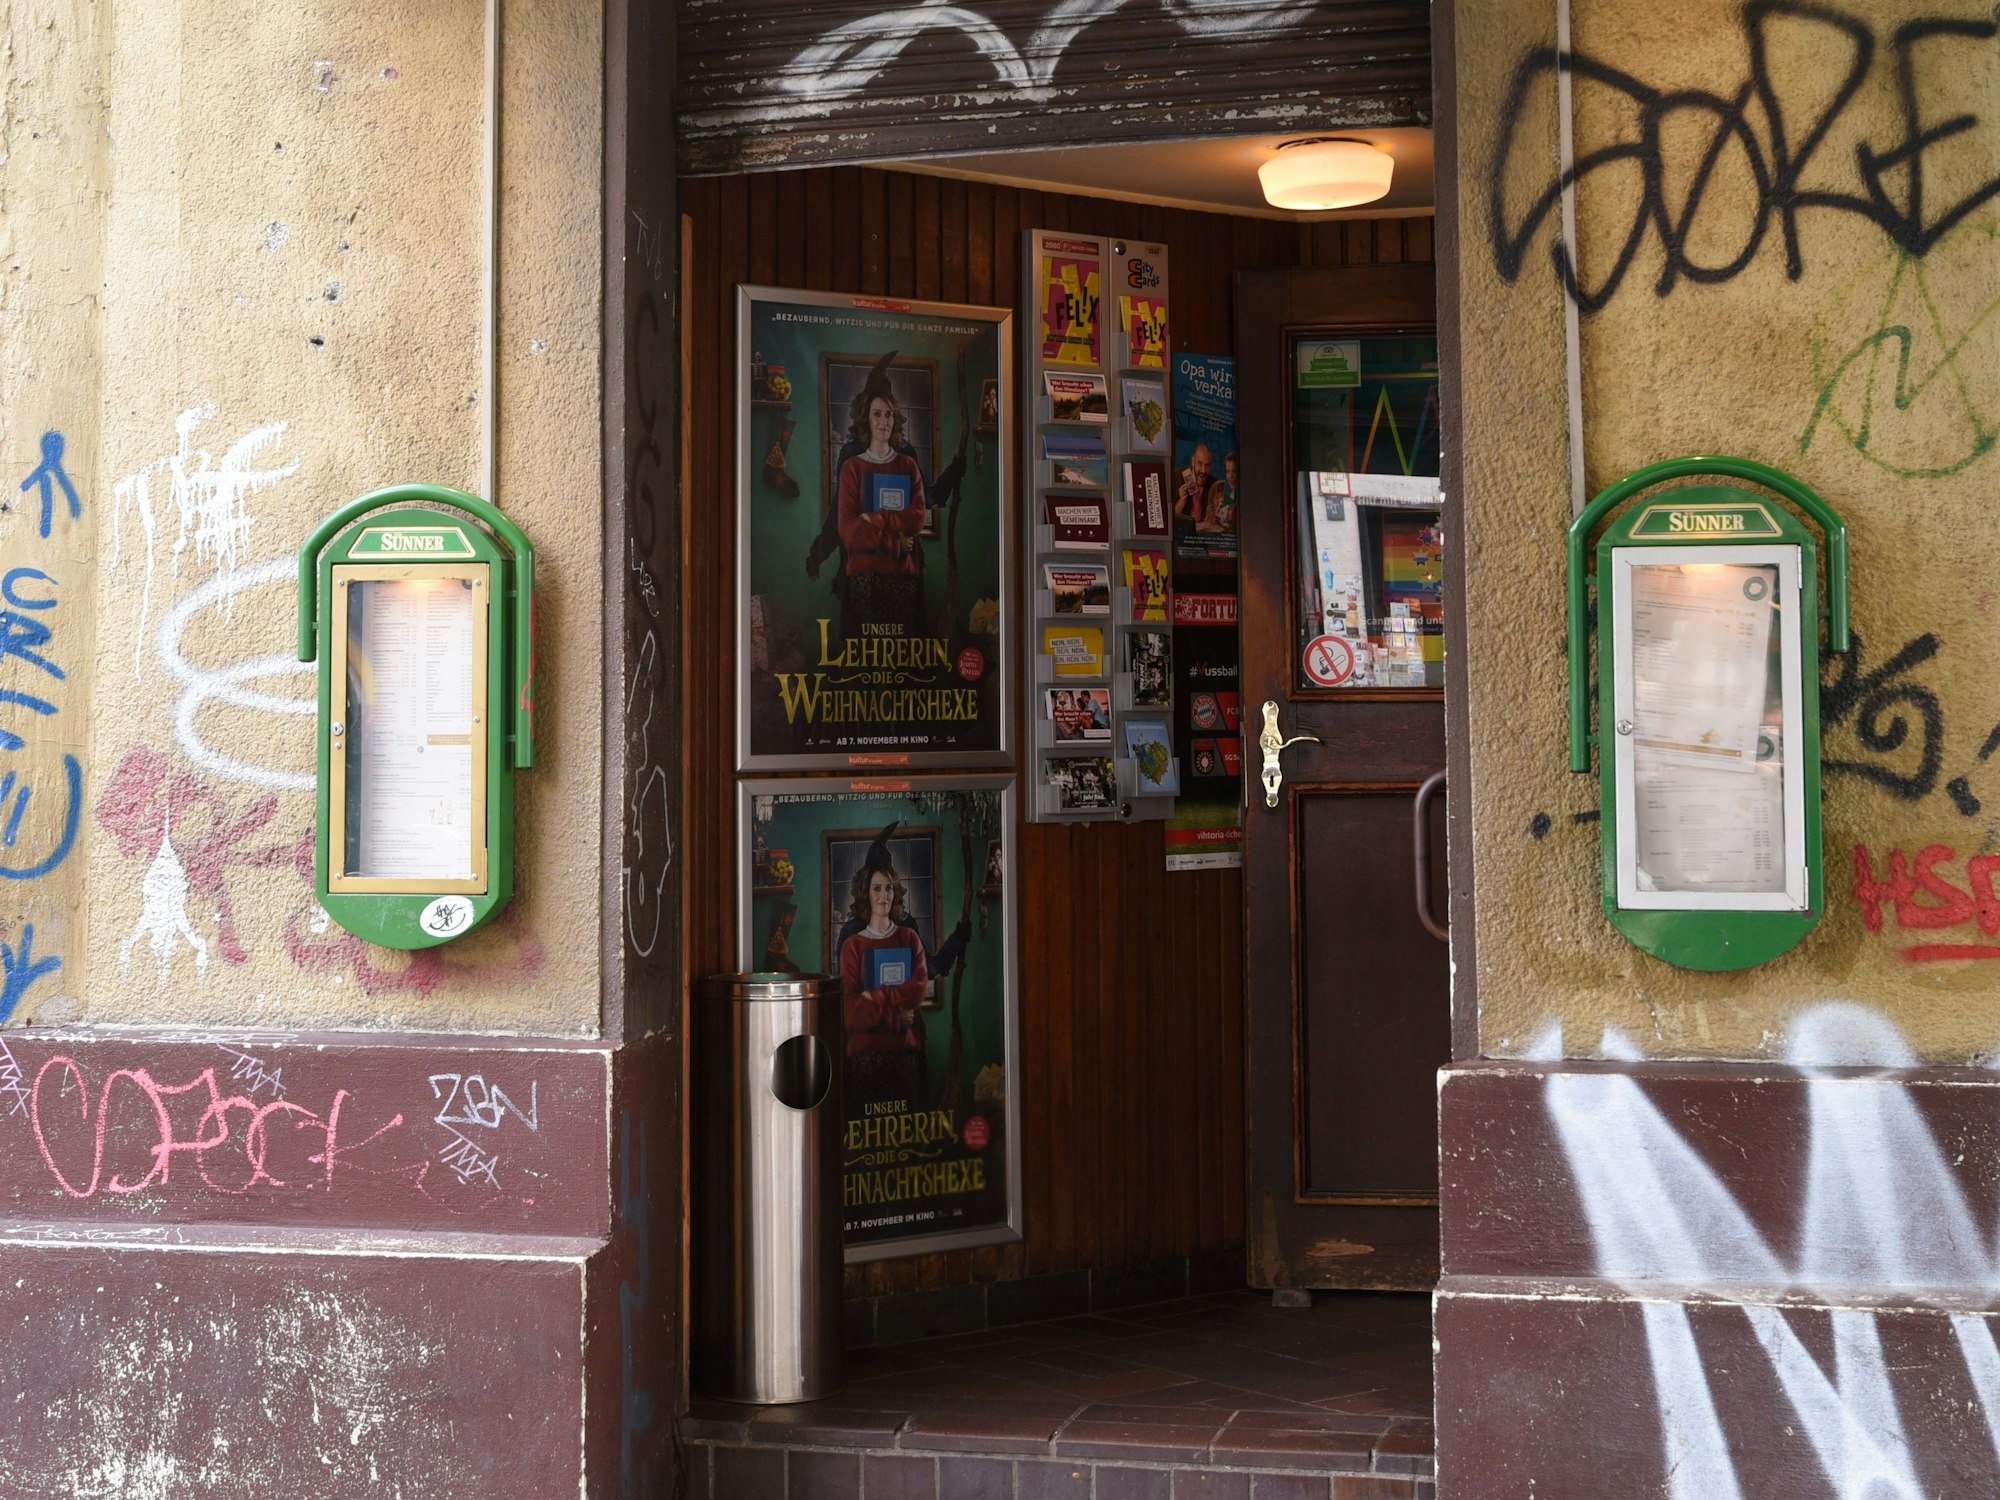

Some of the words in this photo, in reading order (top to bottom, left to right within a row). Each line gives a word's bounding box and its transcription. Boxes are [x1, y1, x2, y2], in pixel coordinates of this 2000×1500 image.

[1181, 359, 1205, 381] Opa
[1210, 368, 1236, 385] wir
[1194, 380, 1235, 400] verka
[1669, 511, 1745, 532] SÜNNER
[381, 532, 444, 551] SÜNNER
[1191, 598, 1239, 619] FORTU
[861, 623, 904, 636] UNSERE
[816, 618, 953, 672] LEHRERIN,
[872, 672, 894, 684] DIE
[773, 672, 980, 725] WEIHNACHTSHEXE
[836, 737, 848, 746] AB
[849, 737, 857, 745] 7.
[857, 736, 899, 745] NOVEMBER
[900, 735, 909, 745] IM
[910, 735, 929, 745] KINO
[838, 792, 867, 802] WITZIG
[868, 791, 886, 801] UND
[864, 1100, 908, 1115] UNSERE
[844, 1109, 958, 1151] EHRERIN,
[876, 1150, 897, 1165] DIE
[853, 1221, 860, 1229] 7.
[861, 1215, 904, 1228] NOVEMBER
[905, 1214, 915, 1222] IM
[916, 1210, 935, 1221] KINO
